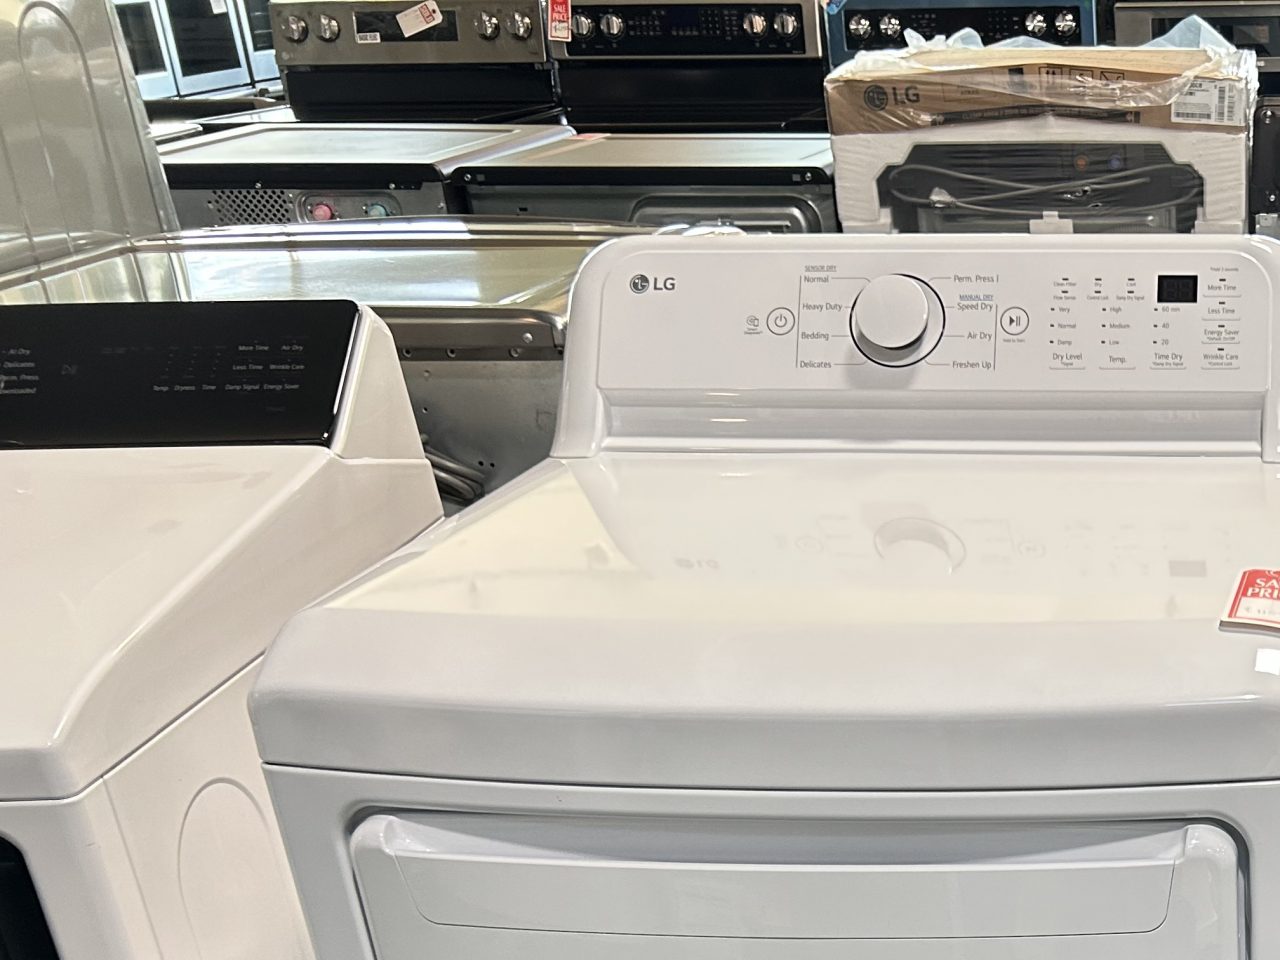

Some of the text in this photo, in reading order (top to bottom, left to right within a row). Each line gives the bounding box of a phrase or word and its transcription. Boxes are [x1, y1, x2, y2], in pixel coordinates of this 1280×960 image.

[892, 85, 920, 105] LG
[804, 275, 829, 283] Normal
[653, 277, 676, 291] LG
[802, 303, 842, 312] Heavy Duty
[957, 302, 993, 312] Speed Dry
[1109, 306, 1122, 314] High
[801, 331, 829, 341] Bedding
[967, 332, 992, 341] Air Dry
[1204, 329, 1223, 337] Energy
[1052, 353, 1063, 362] Dry
[1171, 353, 1183, 362] Dry
[952, 361, 992, 370] Freshen Up
